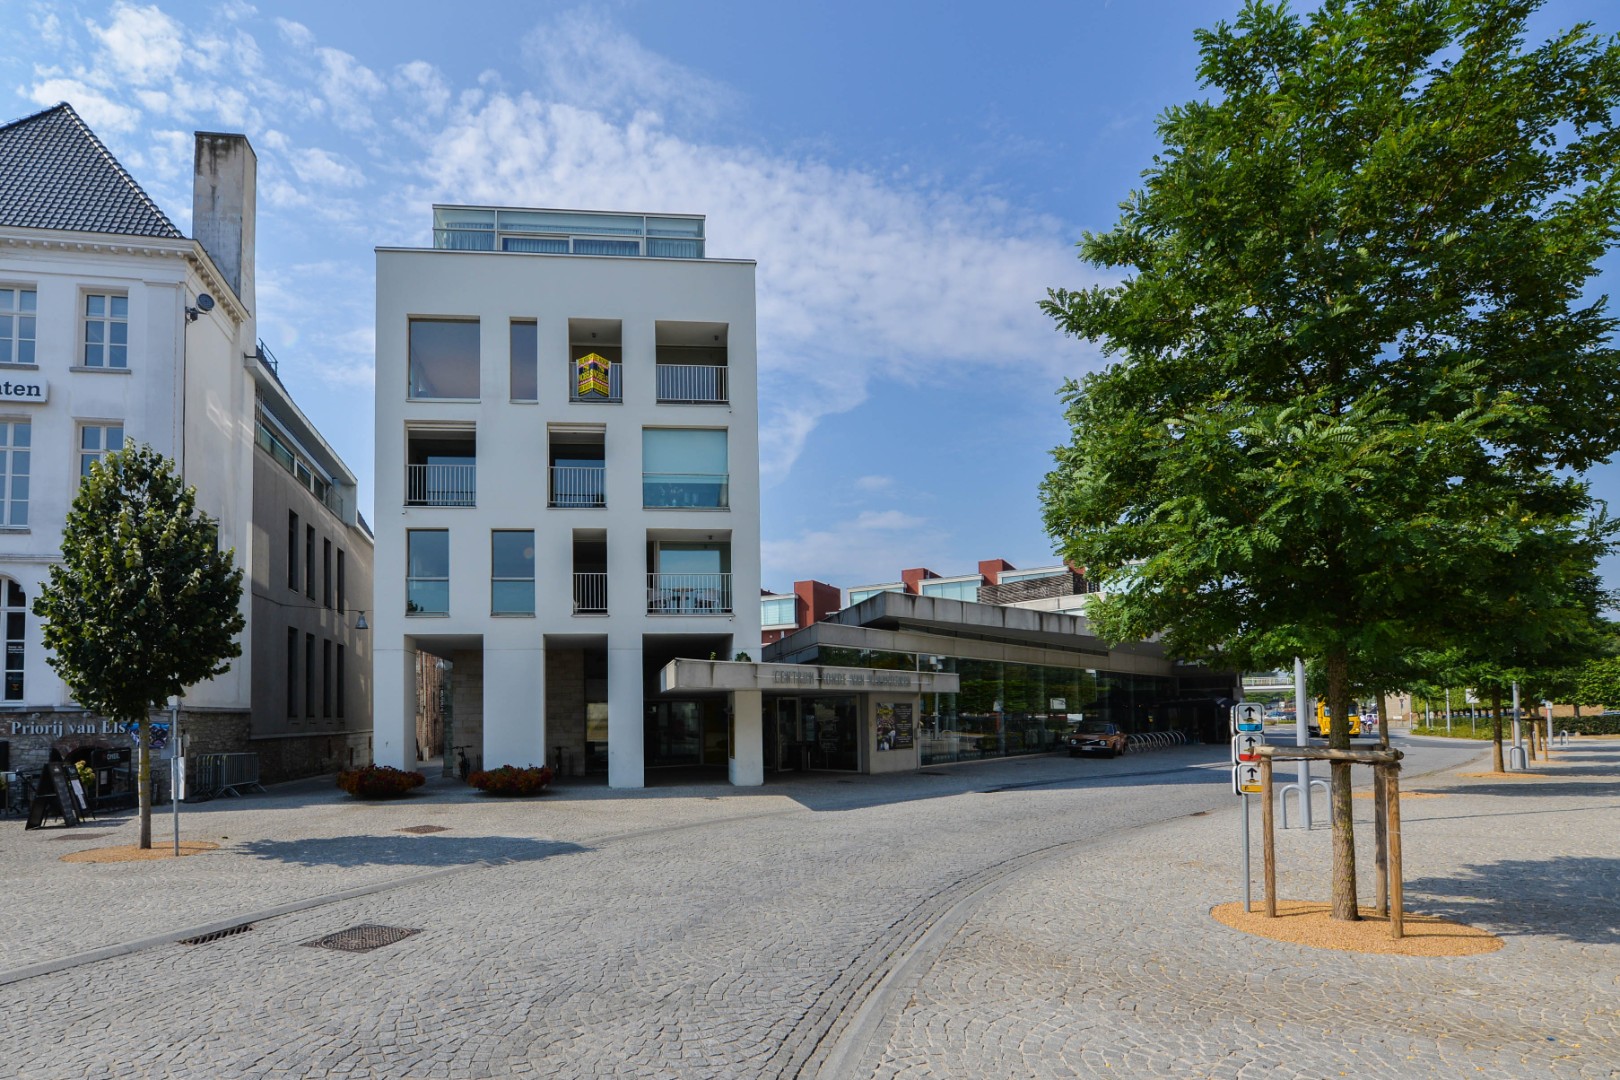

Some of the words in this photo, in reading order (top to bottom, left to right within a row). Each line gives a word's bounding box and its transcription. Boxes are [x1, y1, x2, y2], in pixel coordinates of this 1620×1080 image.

[0, 381, 41, 397] ten
[11, 720, 63, 738] Priorij
[68, 723, 96, 734] van
